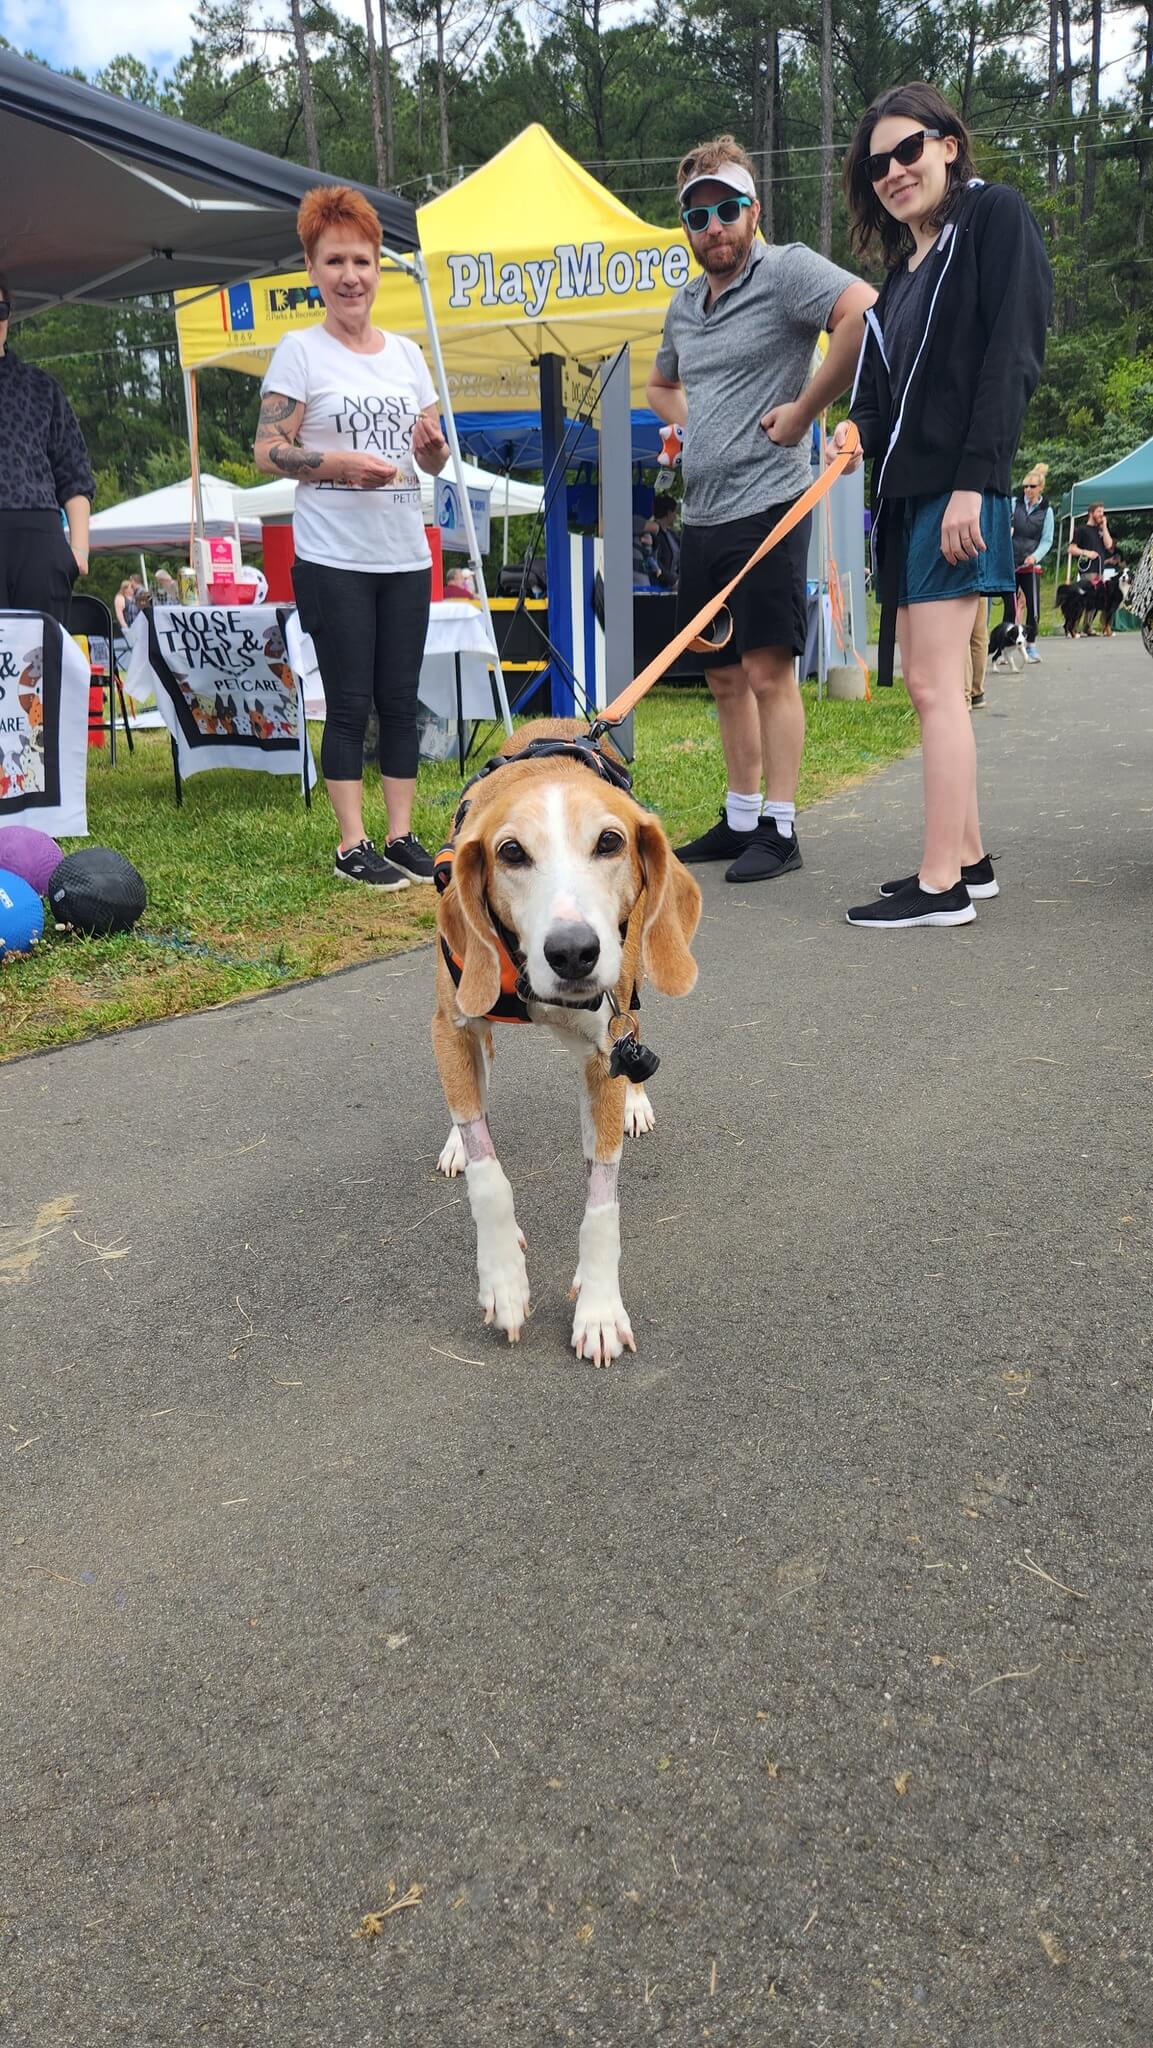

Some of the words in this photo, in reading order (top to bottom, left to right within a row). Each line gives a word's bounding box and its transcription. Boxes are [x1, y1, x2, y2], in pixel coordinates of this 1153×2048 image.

[448, 241, 690, 317] PlayMore
[343, 395, 417, 415] NOSE
[328, 411, 401, 433] TOES
[345, 430, 413, 450] TAILS
[393, 493, 411, 504] PET
[170, 611, 246, 633] NOSE
[159, 630, 232, 652] TOES
[242, 629, 264, 651] &
[177, 647, 256, 669] TAILS
[0, 716, 25, 732] ARE
